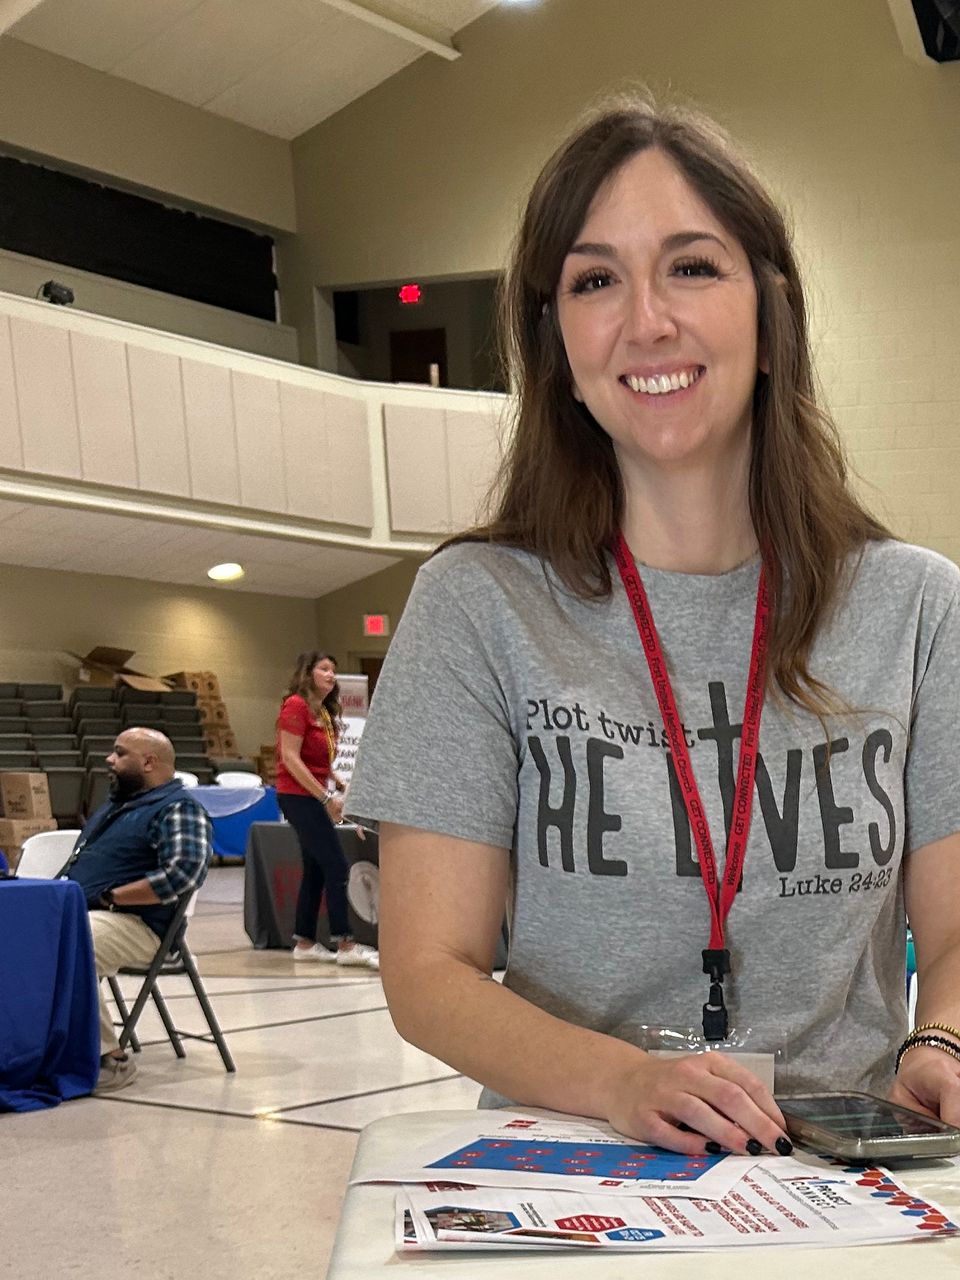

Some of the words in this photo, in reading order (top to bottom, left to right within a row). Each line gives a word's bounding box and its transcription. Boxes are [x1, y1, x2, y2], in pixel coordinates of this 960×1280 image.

[526, 699, 590, 731] Plot
[736, 753, 753, 813] CONNECTED
[528, 735, 628, 877] HE
[689, 798, 701, 819] GET
[734, 815, 744, 835] GET
[693, 820, 718, 885] CONNECTED
[726, 842, 740, 885] Welcome
[779, 875, 842, 898] Luke
